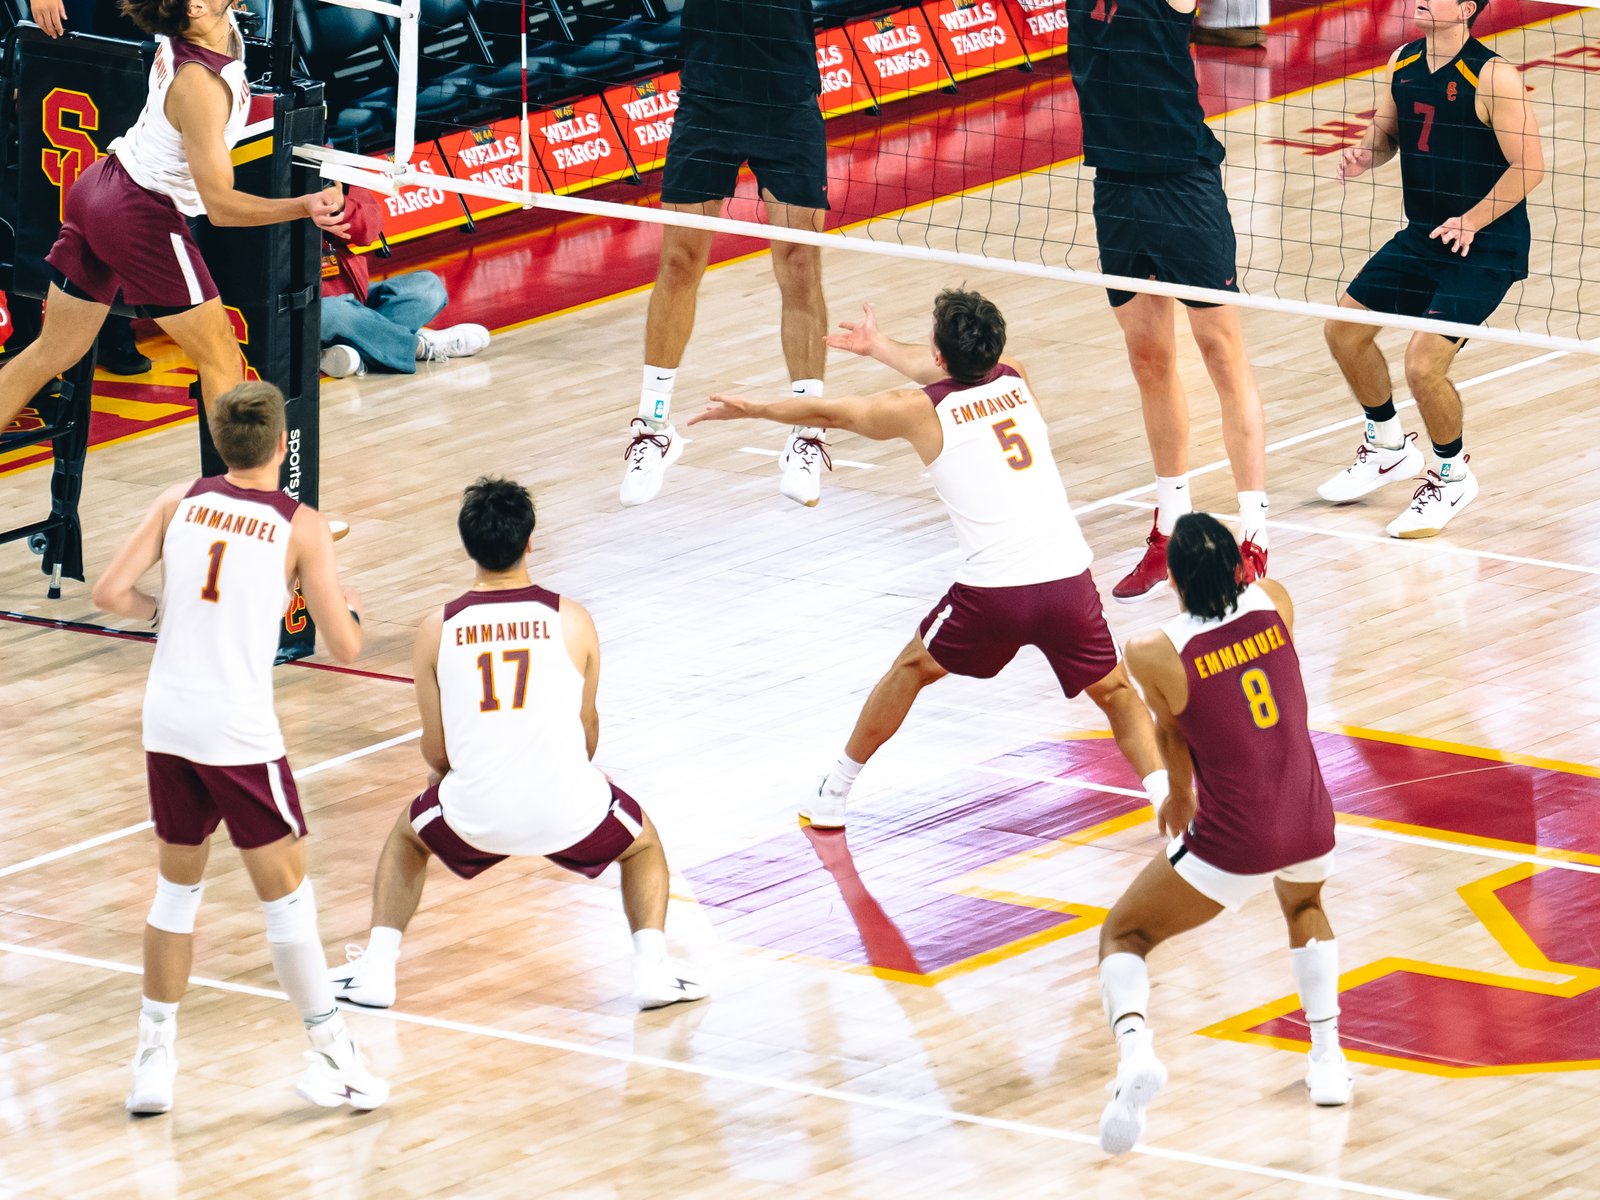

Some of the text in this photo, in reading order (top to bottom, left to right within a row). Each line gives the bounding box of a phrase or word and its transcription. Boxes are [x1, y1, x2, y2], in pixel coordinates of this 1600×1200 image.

[940, 2, 996, 32] WELLS
[1026, 9, 1069, 37] FARG
[863, 25, 922, 54] WELLS
[951, 25, 1006, 56] FARGO
[874, 48, 931, 78] FARGO
[541, 113, 600, 145] WELLS
[1413, 101, 1436, 153] 7
[458, 136, 520, 168] WELLS
[552, 137, 610, 170] FARGO
[384, 187, 445, 217] FARGO
[991, 417, 1033, 471] 5
[288, 429, 302, 495] sports
[185, 505, 277, 543] EMMANUEL
[201, 540, 227, 603] 1
[456, 621, 550, 646] EMMANUEL
[1194, 624, 1285, 679] EMMANUEL
[477, 648, 530, 712] 17
[1240, 667, 1280, 729] 8
